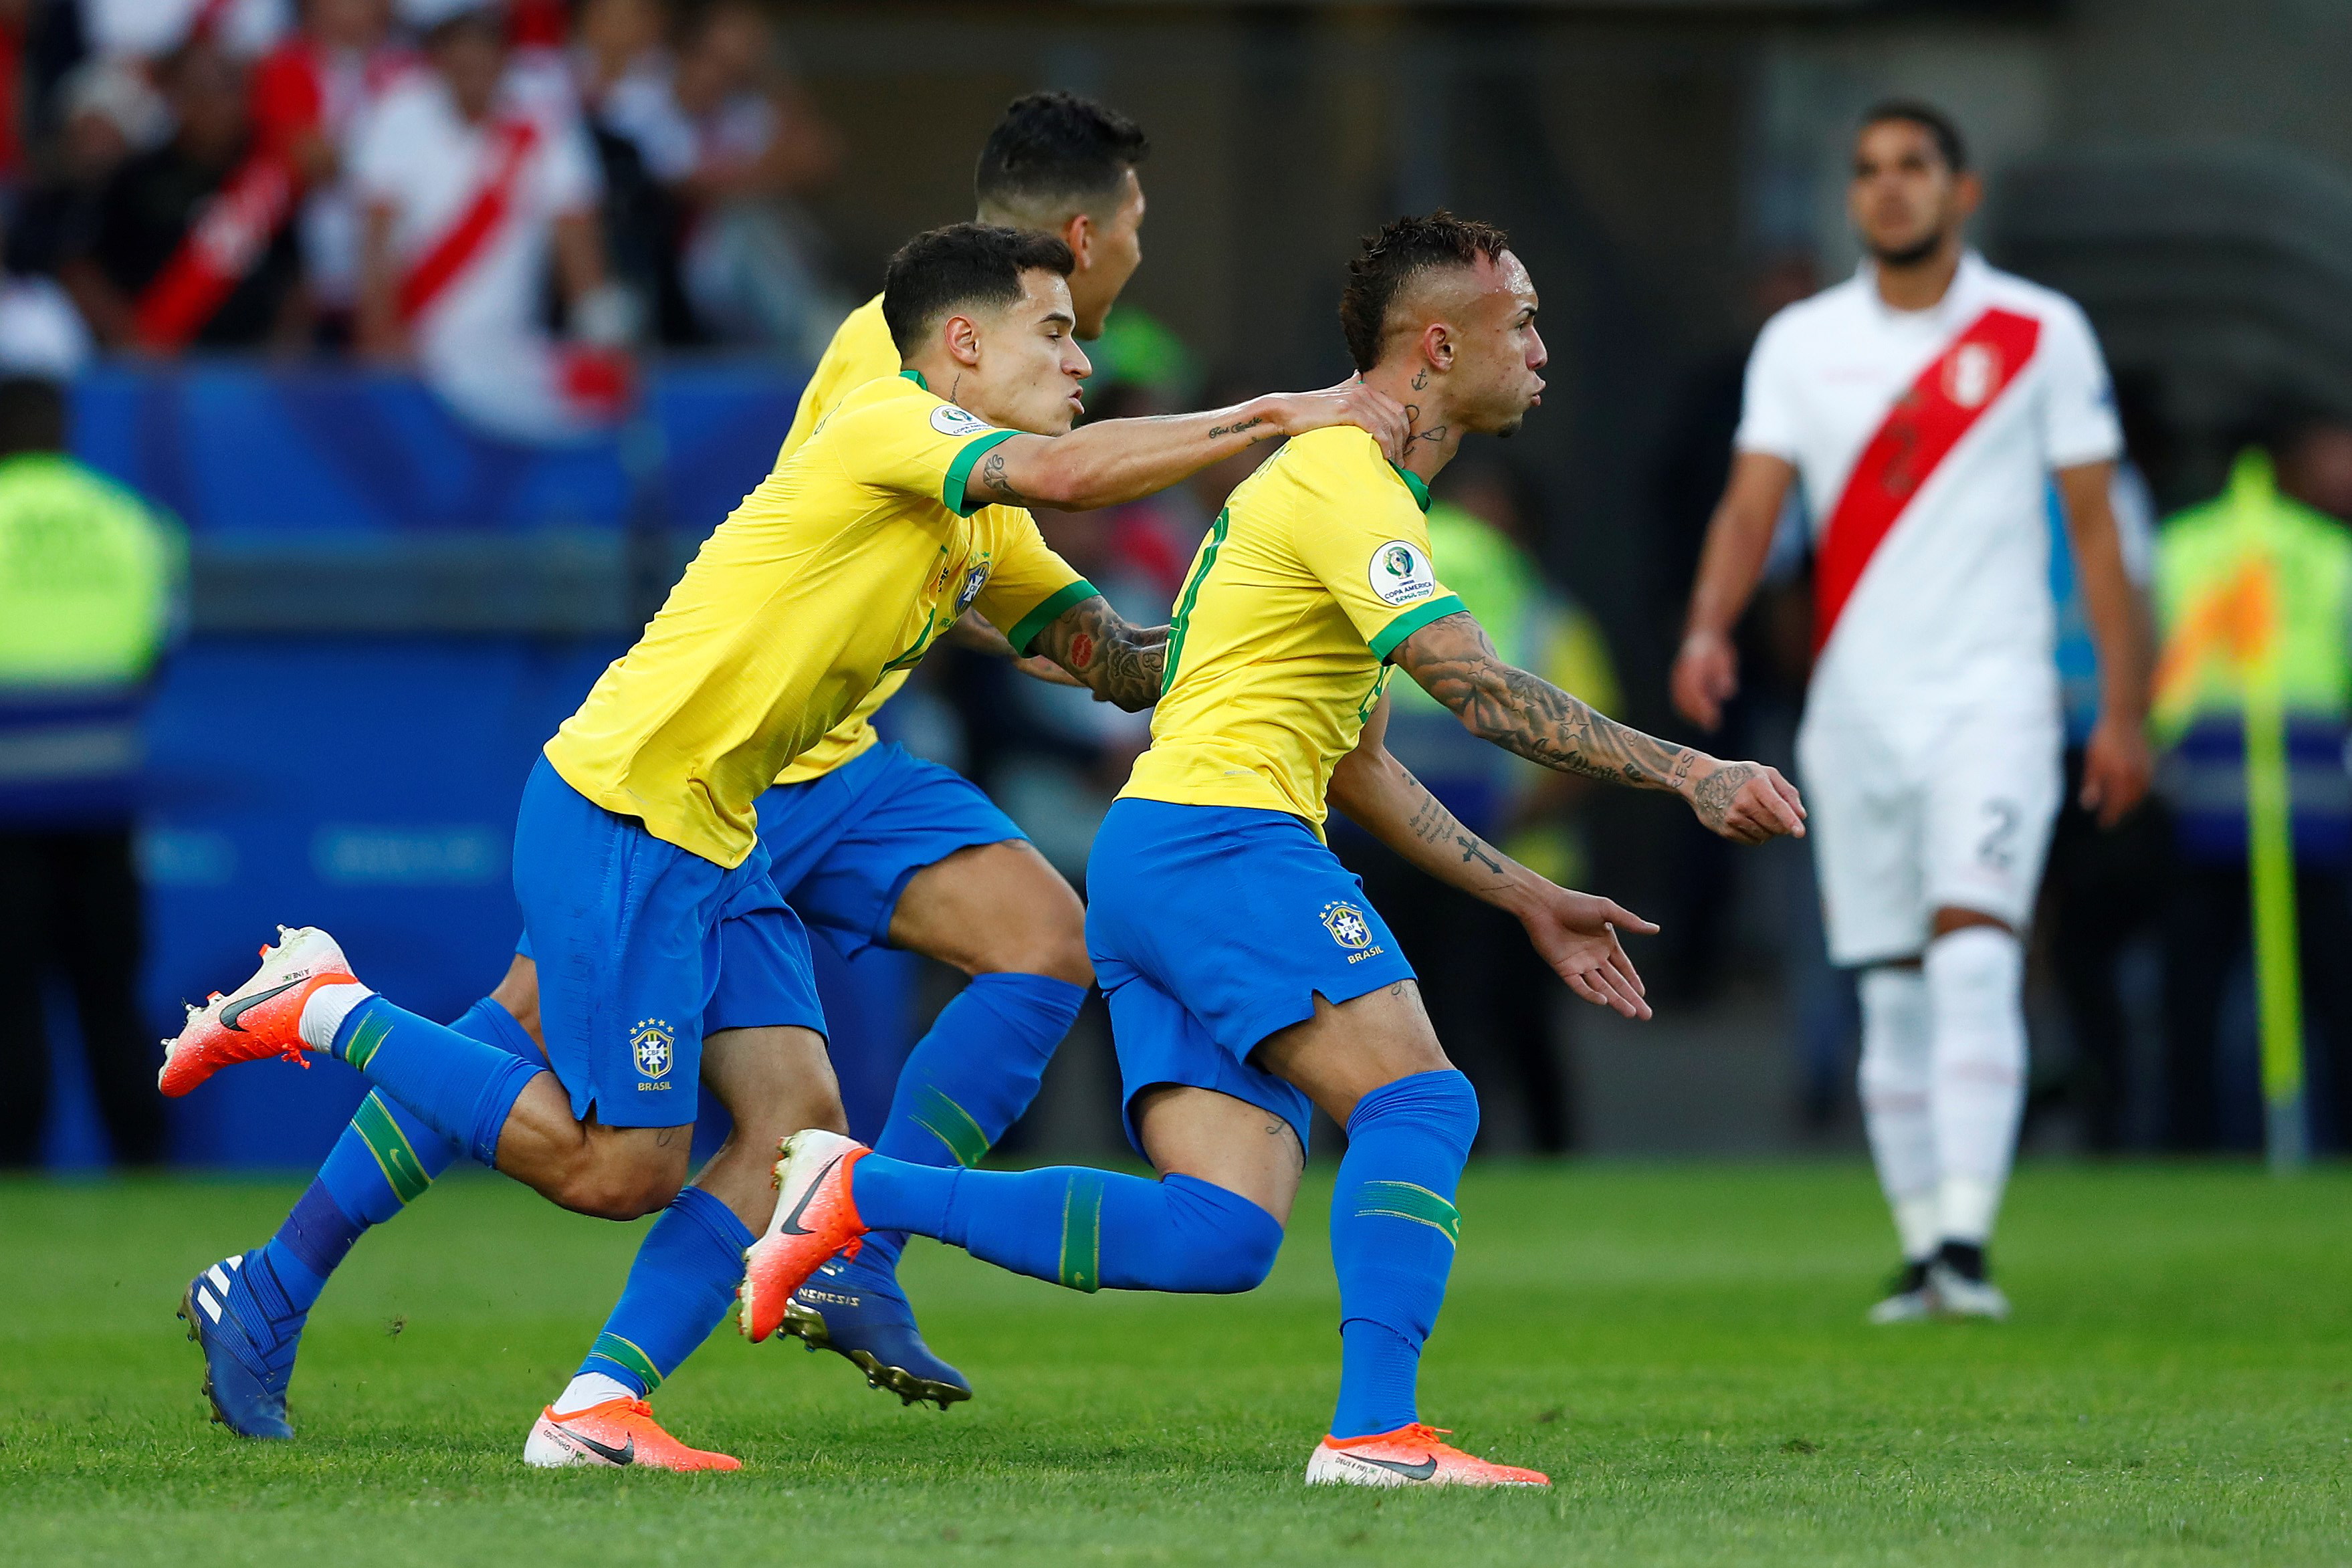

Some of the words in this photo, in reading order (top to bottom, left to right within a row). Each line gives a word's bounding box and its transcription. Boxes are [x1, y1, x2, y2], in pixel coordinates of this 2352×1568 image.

[1384, 588, 1403, 599] COPA
[1404, 581, 1432, 592] AMERICA
[1976, 797, 2021, 871] 2
[1343, 924, 1356, 932] CBF
[1347, 945, 1385, 964] BRASIL
[637, 1081, 673, 1092] BRASIL
[798, 1288, 860, 1307] NEMESIS
[543, 1430, 570, 1451] COUTINHO
